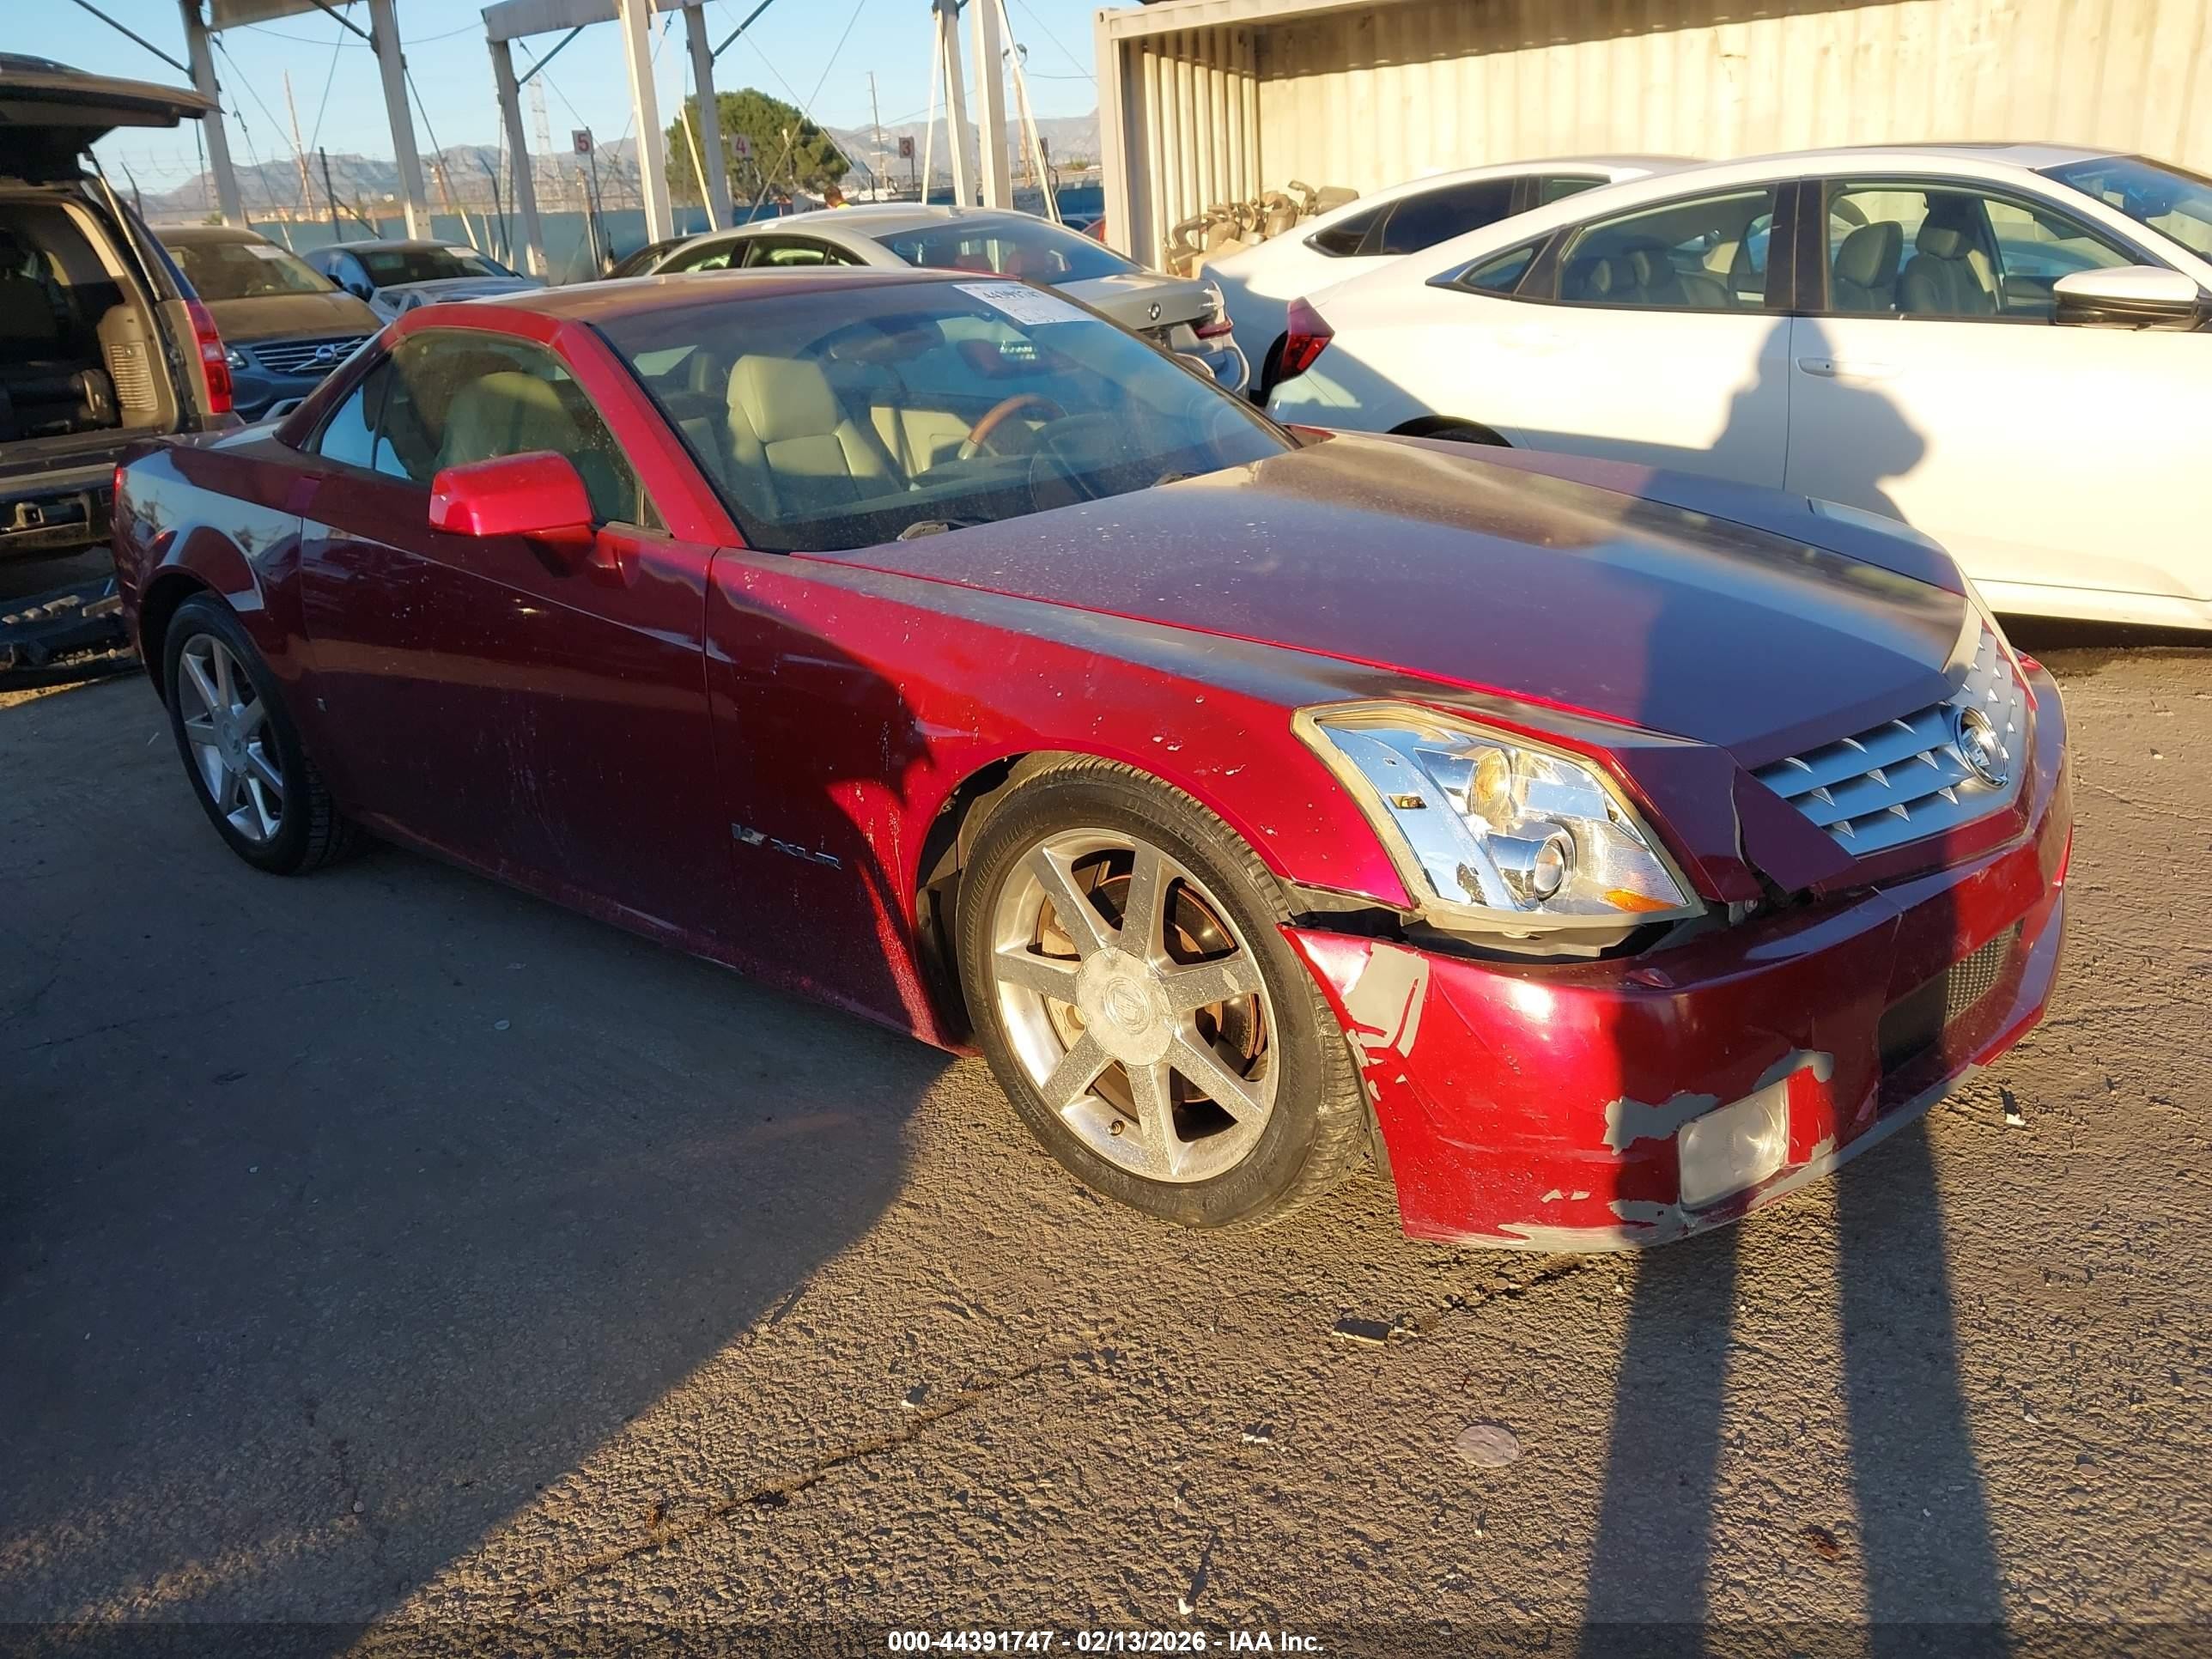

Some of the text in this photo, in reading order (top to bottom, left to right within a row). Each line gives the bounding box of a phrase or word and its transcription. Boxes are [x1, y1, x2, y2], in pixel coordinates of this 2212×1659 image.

[577, 132, 590, 152] 5
[736, 137, 746, 155] 4
[902, 139, 912, 156] 3
